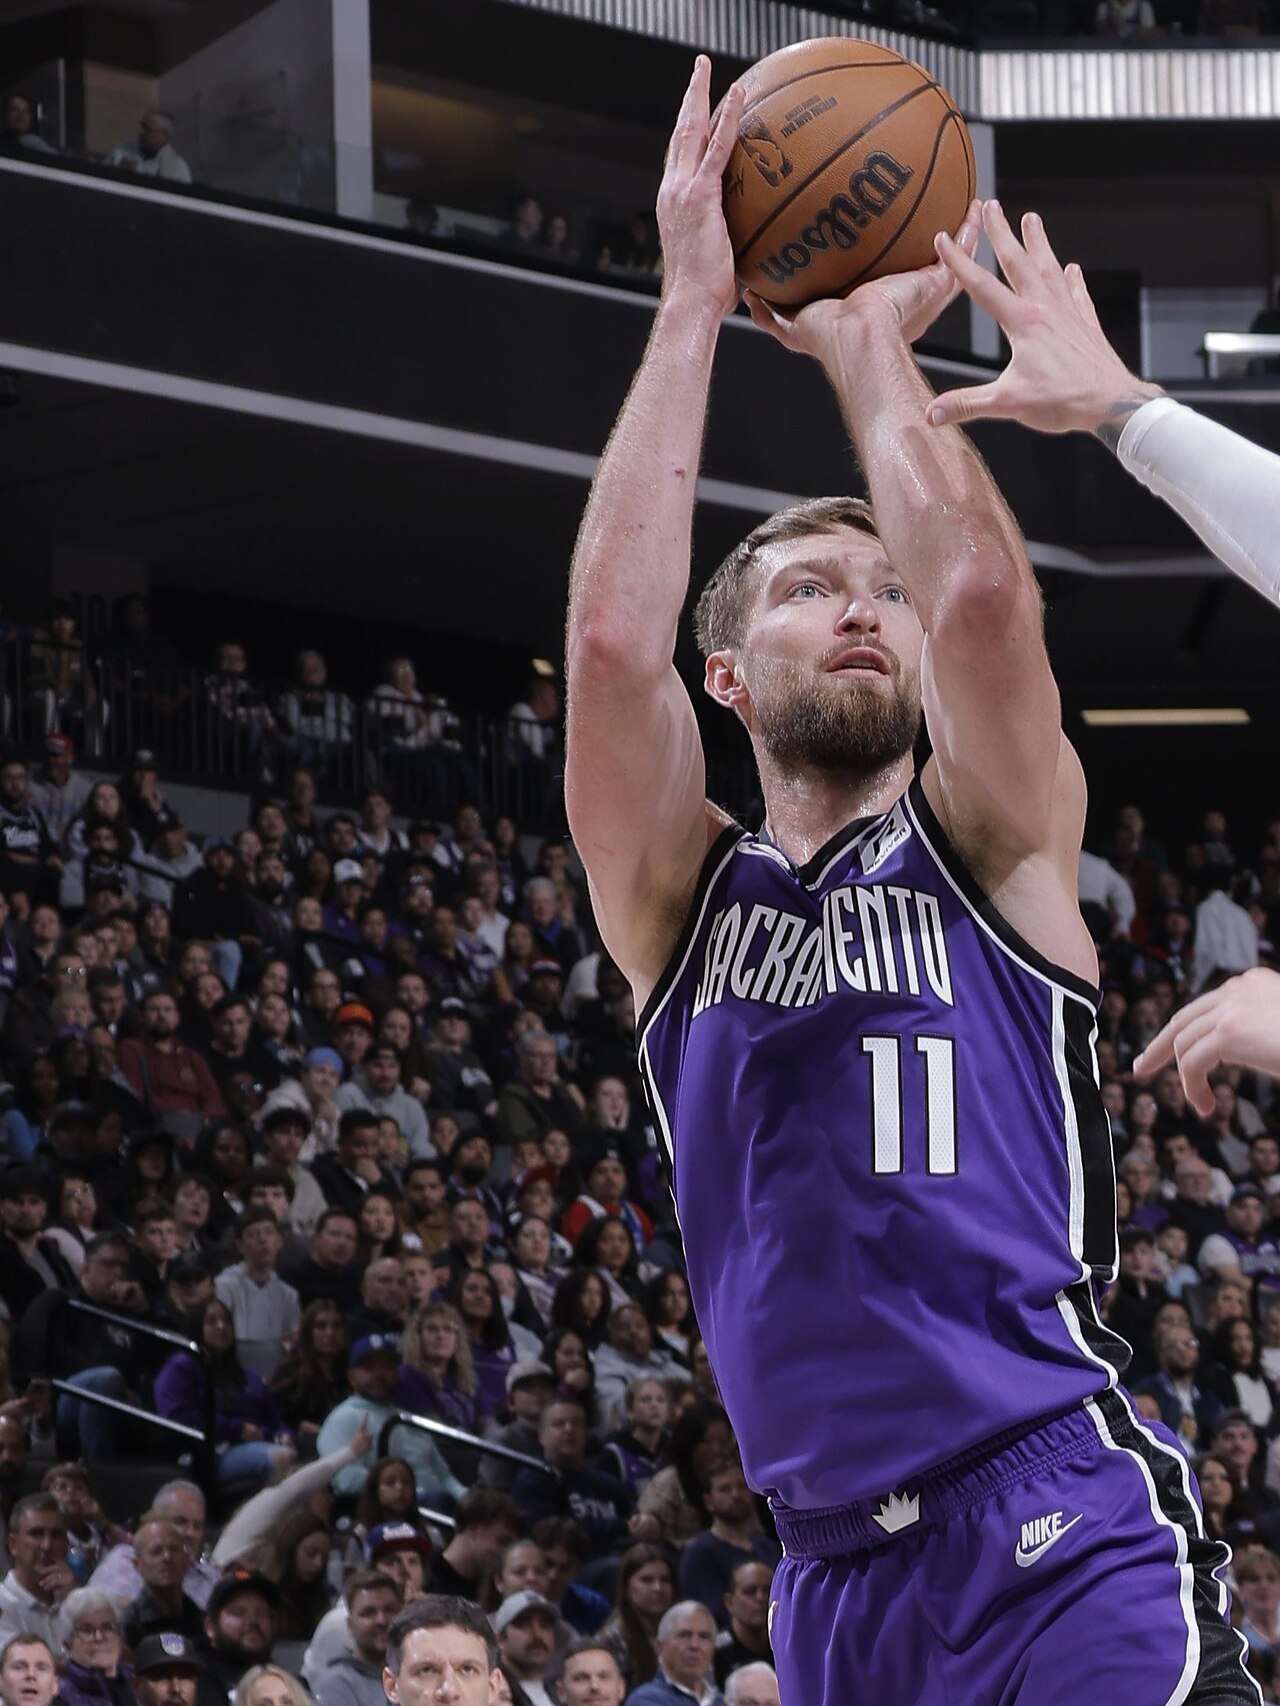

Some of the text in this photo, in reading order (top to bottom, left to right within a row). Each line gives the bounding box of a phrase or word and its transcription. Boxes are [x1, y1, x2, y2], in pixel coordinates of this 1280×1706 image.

[757, 150, 915, 283] Wilson
[860, 1034, 957, 1175] 11
[1021, 1511, 1063, 1550] NIKE
